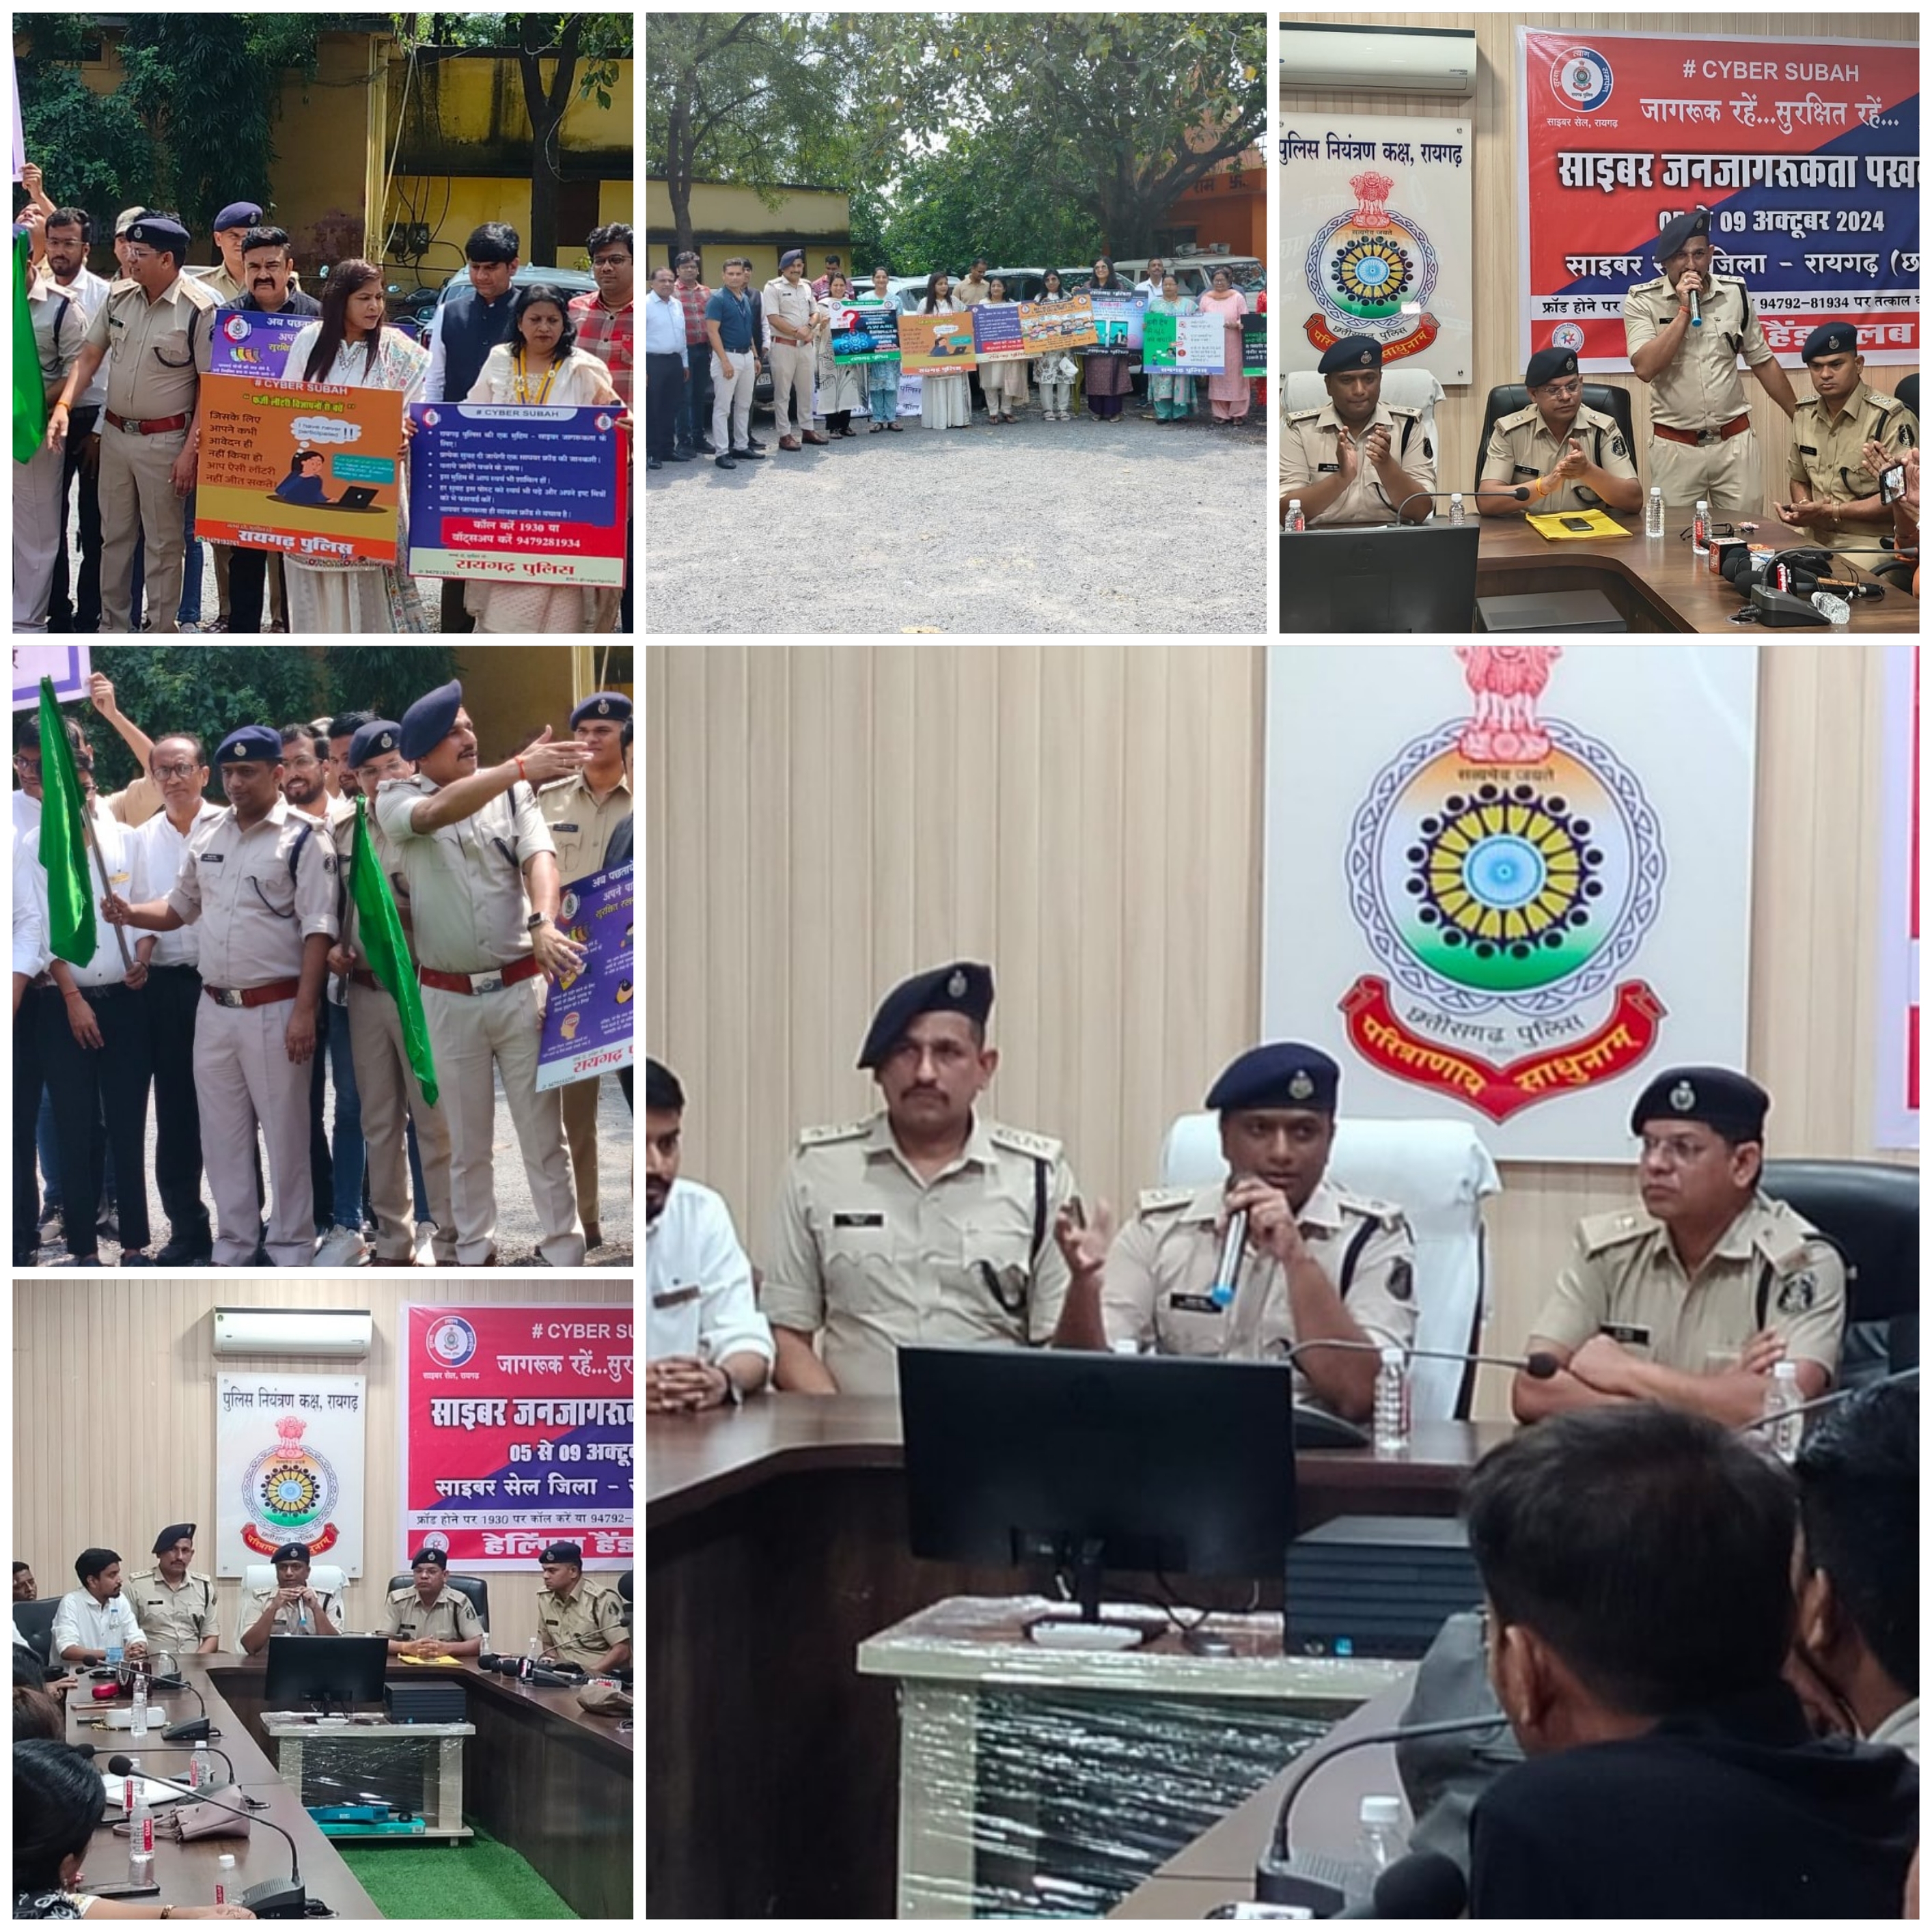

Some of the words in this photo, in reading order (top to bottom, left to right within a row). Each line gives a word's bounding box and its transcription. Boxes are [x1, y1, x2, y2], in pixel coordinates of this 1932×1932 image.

[1683, 59, 1696, 79] #
[1702, 59, 1779, 80] CYBER
[1784, 63, 1860, 82] SUBAH
[1640, 98, 1722, 124] जागरूक
[1546, 118, 1571, 128] साइबर
[1574, 115, 1591, 128] सेल,
[1594, 120, 1618, 128] रायगढ़
[1280, 130, 1319, 165] पुलिस
[1327, 132, 1376, 161] नियंत्रण
[1383, 143, 1414, 166] कक्ष,
[1421, 143, 1463, 167] रायगढ़
[1558, 152, 1655, 193] साइबर
[1661, 153, 1858, 189] जनजागरूकता
[1720, 210, 1745, 232] 09
[1752, 210, 1830, 239] अक्टूबर
[1836, 210, 1885, 232] 2024
[1566, 256, 1643, 279] साइबर
[1804, 253, 1879, 278] रायगढ़
[1543, 298, 1569, 314] फ्रॉड
[1573, 298, 1597, 314] होने
[1601, 301, 1620, 312] पर
[1854, 296, 1871, 307] पर
[1875, 296, 1911, 307] तत्काल
[267, 318, 283, 327] अब
[1379, 327, 1407, 341] पुलिस
[1857, 323, 1915, 344] लब
[264, 380, 303, 390] CYBER
[307, 383, 347, 395] SUBAH
[210, 410, 240, 421] जिसके
[243, 413, 261, 424] लिए
[210, 425, 234, 434] आपने
[237, 427, 257, 437] कभी
[209, 437, 240, 447] आवेदन
[243, 439, 253, 448] ही
[208, 449, 225, 458] नहीं
[227, 450, 250, 460] किया
[253, 453, 262, 463] हो
[228, 463, 245, 473] ऐसी
[249, 465, 275, 475] लॉटरी
[206, 473, 223, 483] नहीं
[225, 475, 244, 485] जीत
[473, 519, 496, 530] कॉल
[499, 519, 514, 532] करें
[520, 523, 544, 532] 1930
[549, 524, 560, 533] या
[238, 530, 295, 550] रायगढ़
[301, 537, 354, 559] पुलिस
[498, 534, 512, 544] करें
[516, 536, 581, 548] 9479281934
[456, 559, 516, 574] रायगढ़
[523, 562, 575, 577] पुलिस
[592, 875, 606, 887] अब
[603, 884, 622, 901] अपने
[1517, 1014, 1586, 1047] पुलिस
[574, 1048, 623, 1073] रायगढ़
[532, 1324, 543, 1339] #
[548, 1324, 611, 1339] CYBER
[497, 1355, 564, 1374] जागरूक
[223, 1385, 253, 1412] पुलिस
[258, 1387, 294, 1408] नियंत्रण
[299, 1394, 322, 1411] कक्ष,
[328, 1394, 359, 1412] रायगढ़
[431, 1399, 508, 1431] साइबर
[510, 1444, 532, 1462] 05
[537, 1440, 555, 1461] से
[559, 1444, 580, 1462] 09
[435, 1480, 497, 1498] साइबर
[503, 1473, 540, 1496] सेल
[549, 1473, 597, 1495] जिला
[417, 1512, 437, 1524] फ्रॉड
[441, 1513, 458, 1526] होने
[463, 1515, 478, 1523] पर
[482, 1515, 508, 1524] 1930
[512, 1515, 526, 1523] पर
[530, 1511, 551, 1523] कॉल
[556, 1510, 571, 1523] करें
[575, 1515, 587, 1523] या
